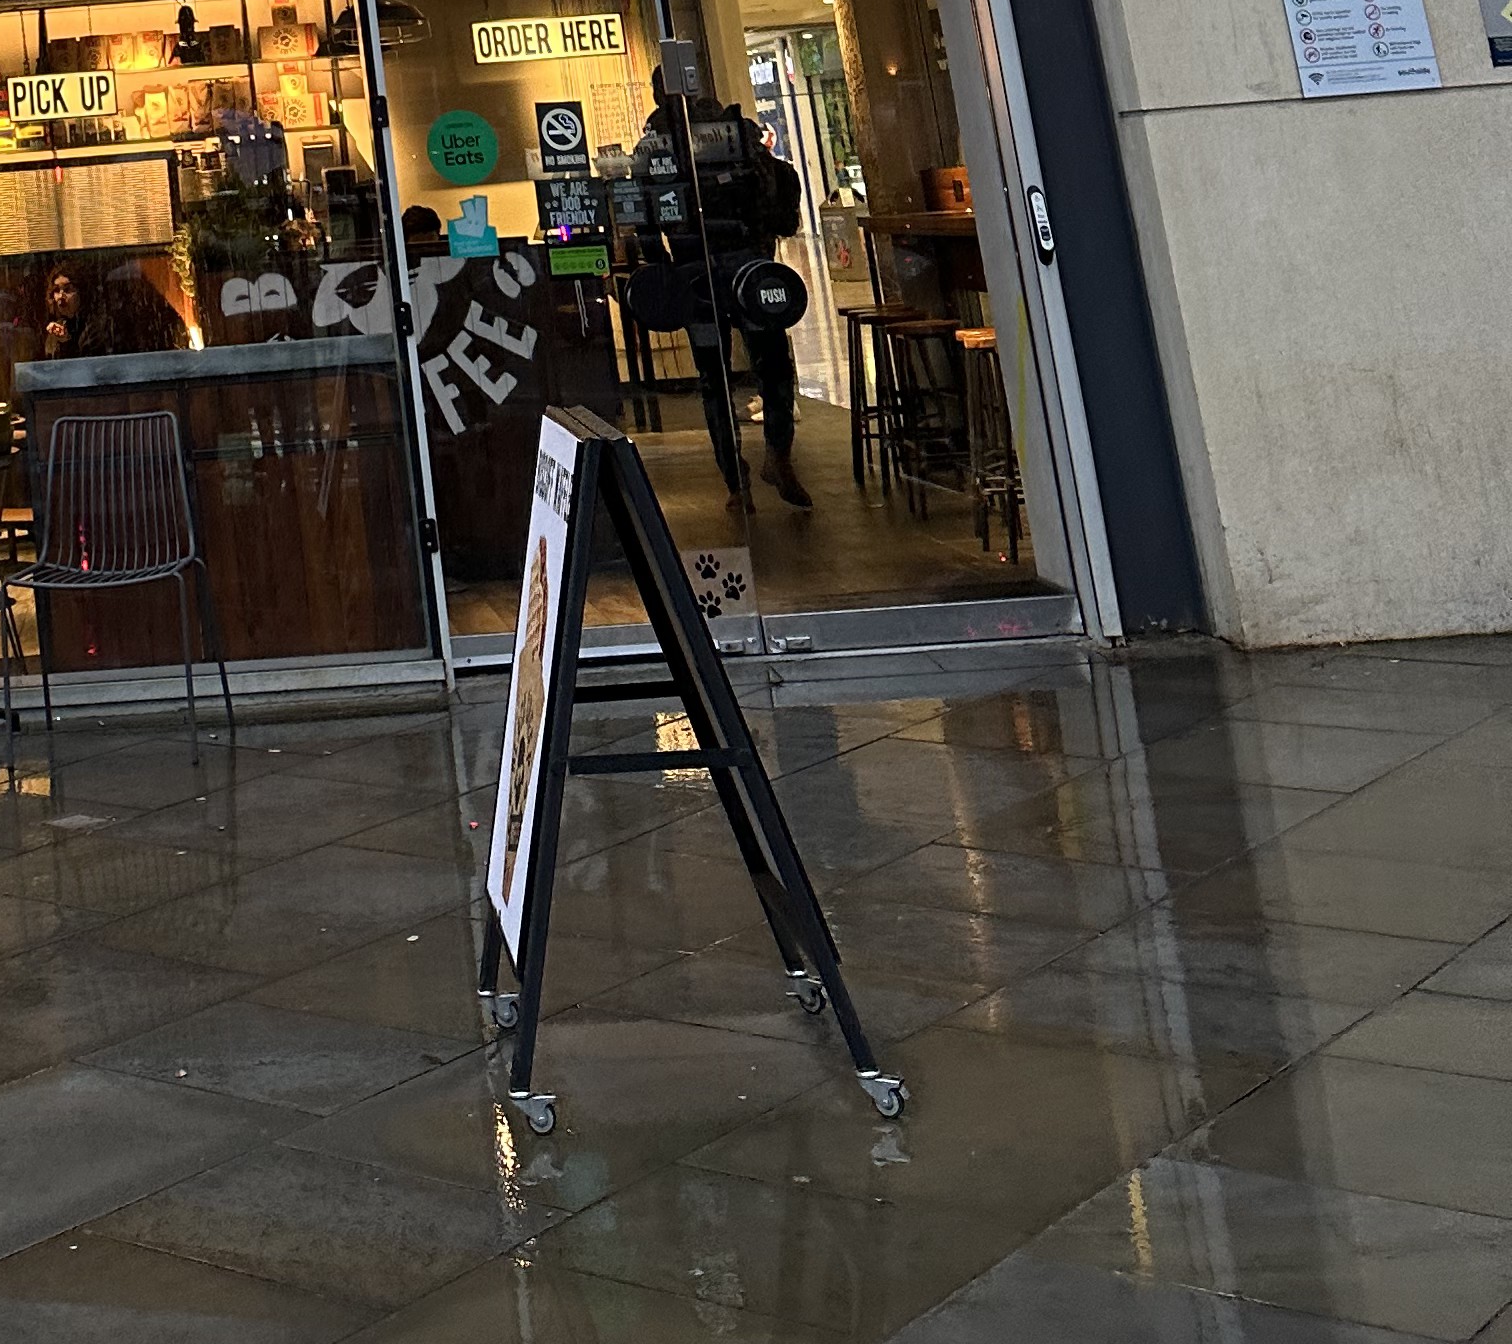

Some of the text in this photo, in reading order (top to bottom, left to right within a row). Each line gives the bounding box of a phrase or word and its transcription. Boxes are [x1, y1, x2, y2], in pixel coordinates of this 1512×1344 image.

[477, 18, 620, 58] ORDER HERE
[12, 75, 110, 117] PICK UP
[440, 134, 481, 149] Uber
[443, 150, 485, 167] Eats
[549, 181, 589, 197] WE ARE
[549, 209, 596, 226] FRIENDLY
[760, 288, 787, 304] PUSH
